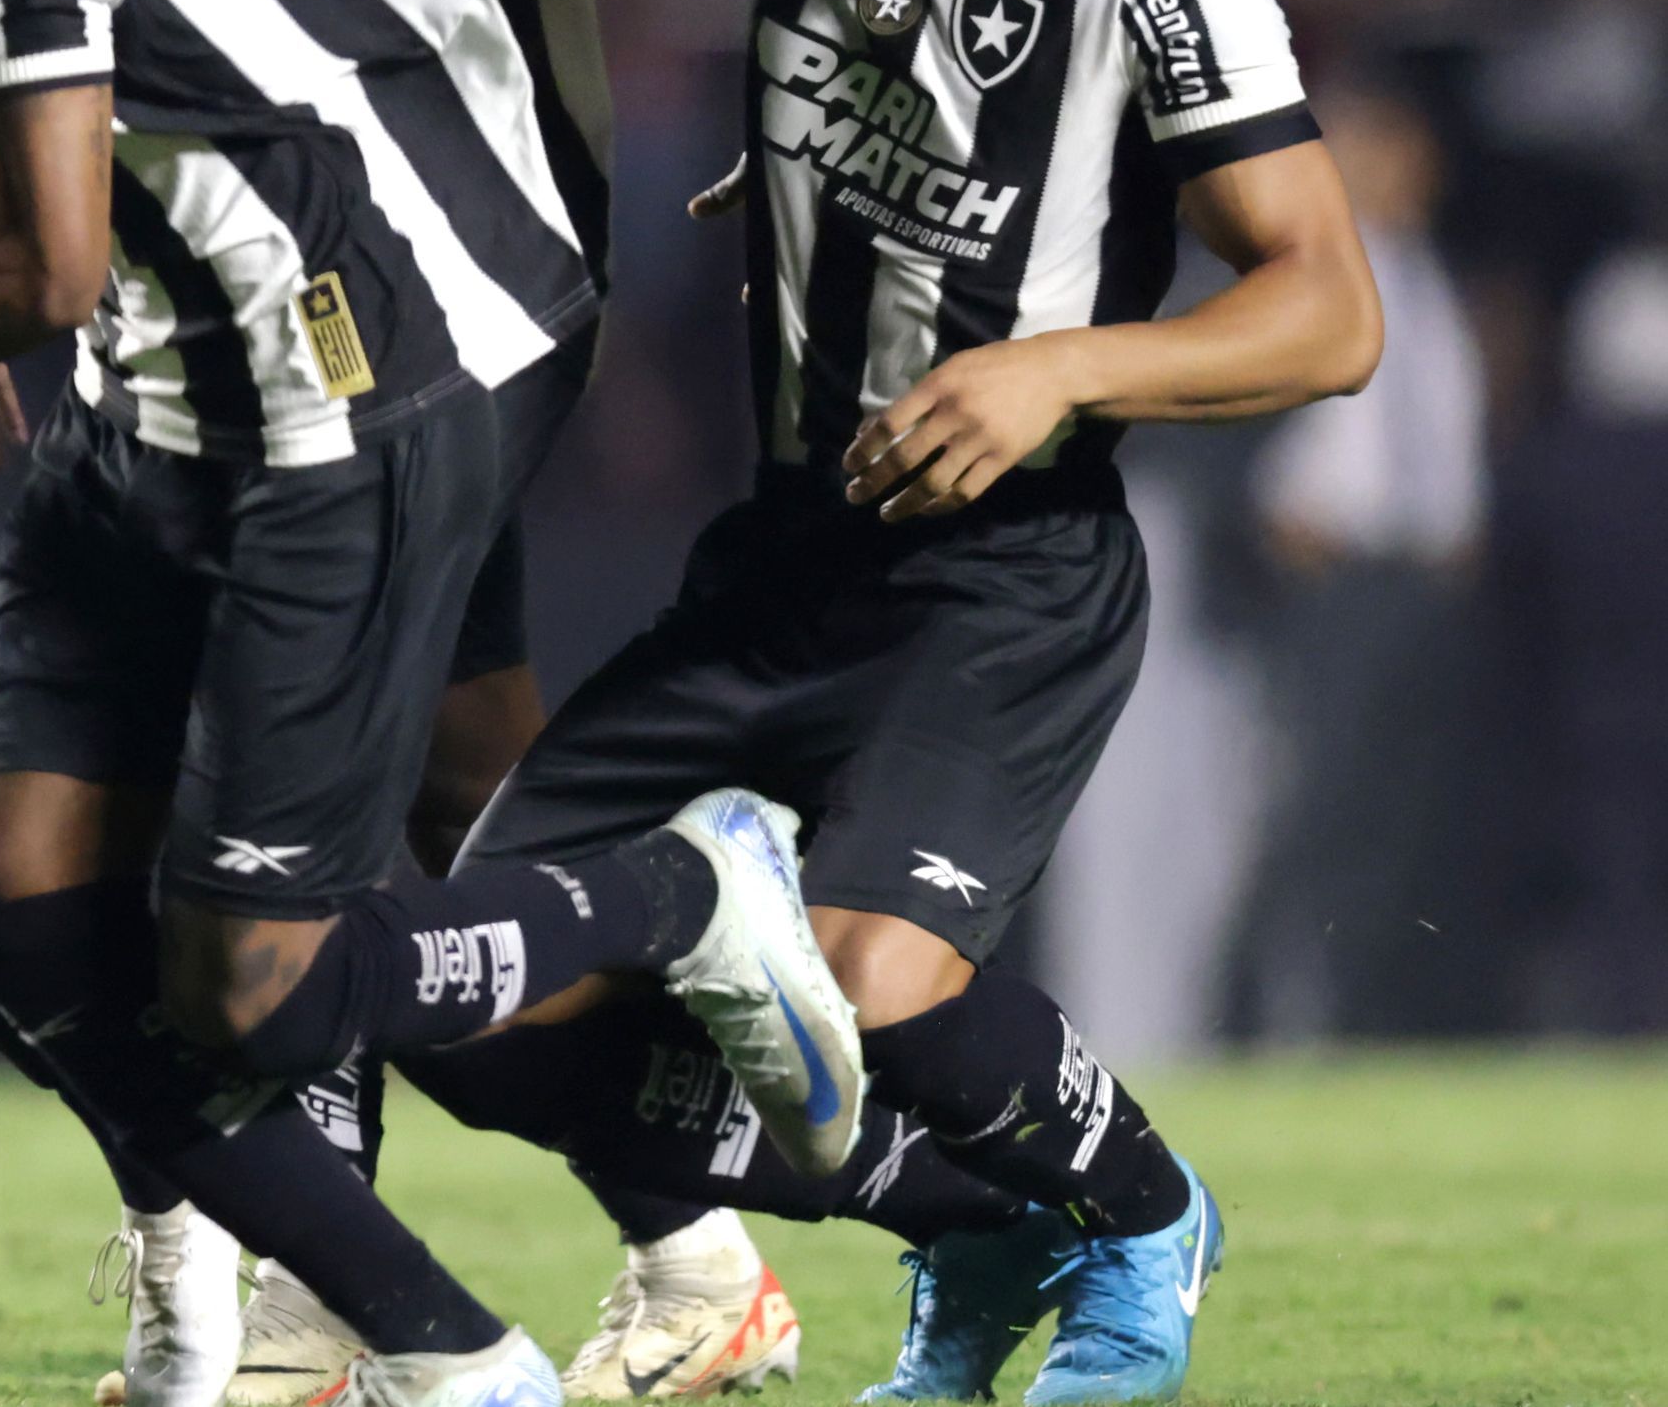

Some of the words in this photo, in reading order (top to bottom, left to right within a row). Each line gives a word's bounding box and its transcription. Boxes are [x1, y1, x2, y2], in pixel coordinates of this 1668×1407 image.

[756, 15, 934, 145] PARI
[762, 83, 1021, 235] MATCH
[834, 186, 896, 230] APOSTAS
[894, 215, 993, 262] ESPORTIVAS
